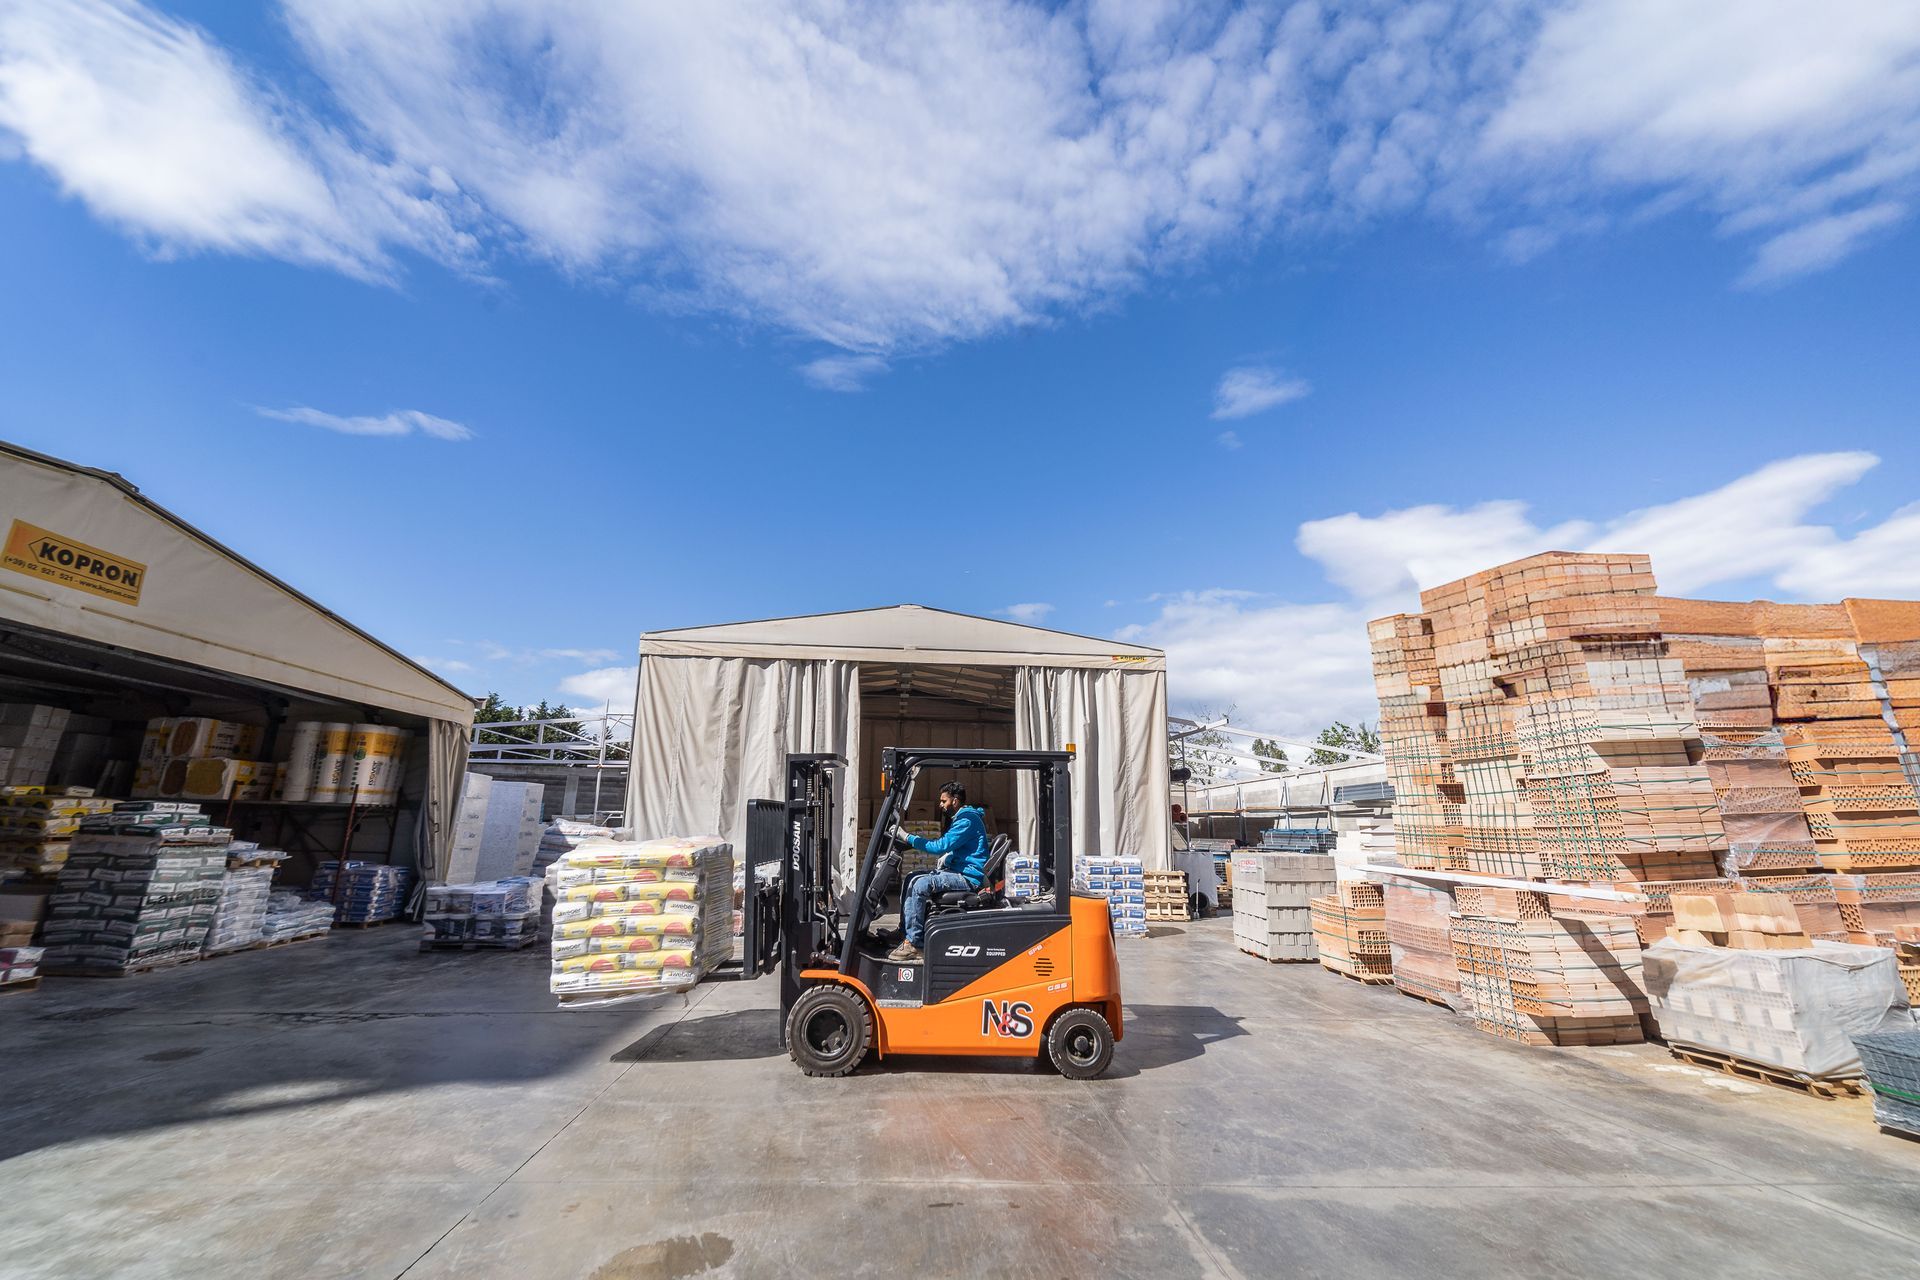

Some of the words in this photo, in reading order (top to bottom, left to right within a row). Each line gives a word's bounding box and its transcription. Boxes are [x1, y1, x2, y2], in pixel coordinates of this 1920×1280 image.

[39, 542, 138, 587] KOPRON
[793, 820, 801, 871] DOOSAN
[945, 946, 981, 957] 30
[982, 1000, 1034, 1038] N&S
